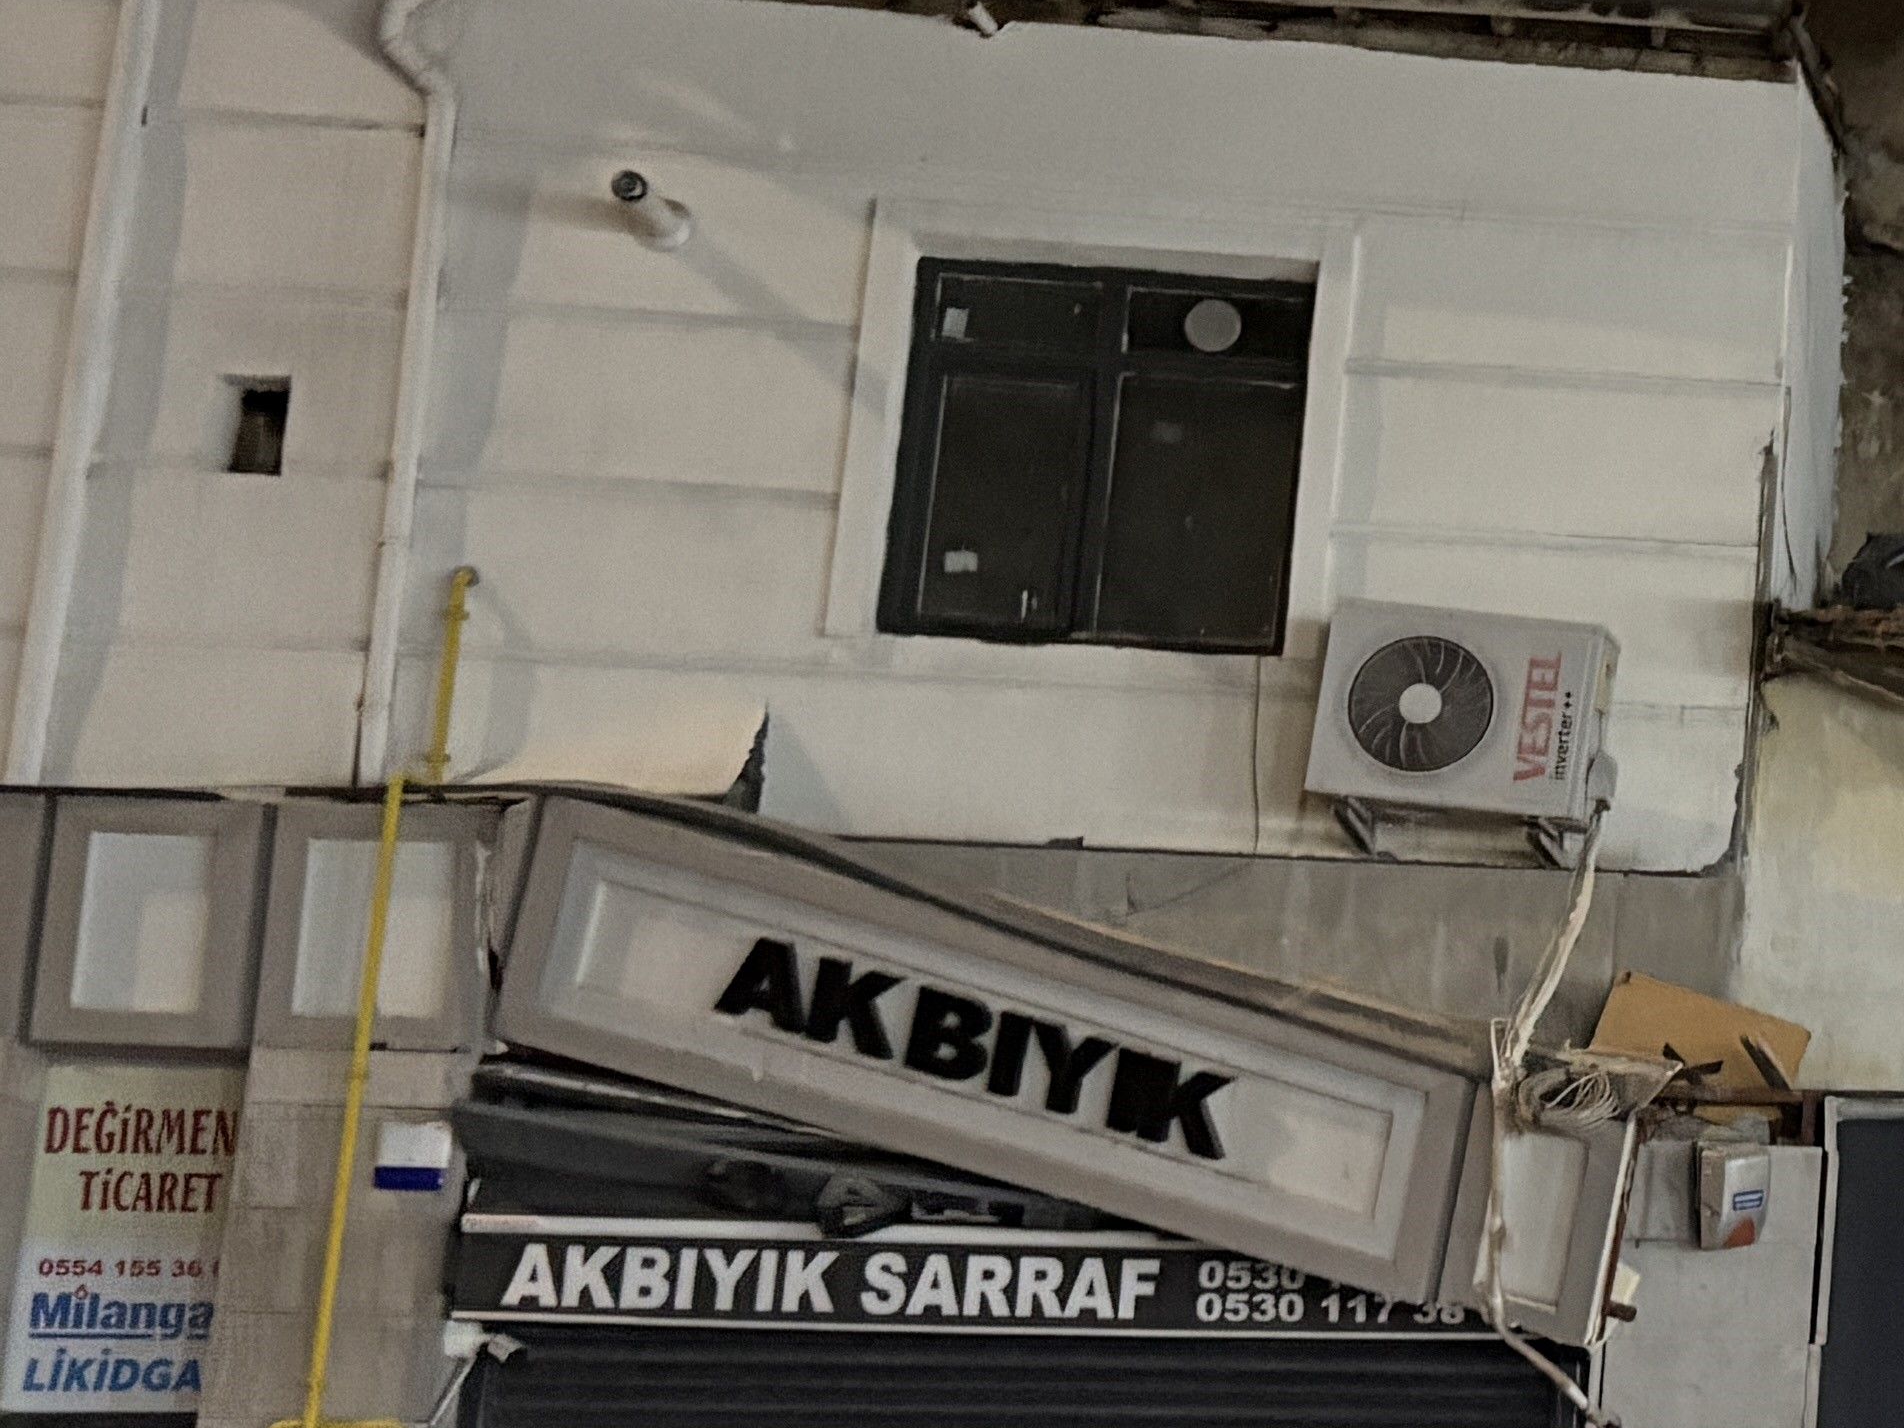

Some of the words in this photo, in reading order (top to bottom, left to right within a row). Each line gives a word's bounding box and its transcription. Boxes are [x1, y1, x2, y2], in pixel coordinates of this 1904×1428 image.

[1512, 651, 1562, 782] VESTEL
[714, 936, 1236, 1159] AKBIYIK
[38, 1258, 103, 1278] 0554
[114, 1259, 162, 1278] 155
[501, 1243, 841, 1314] AKBIYIK
[859, 1251, 1162, 1320] SARRAF
[1199, 1259, 1306, 1290] 0530
[1196, 1292, 1304, 1323] 0530
[1320, 1292, 1394, 1323] 117
[22, 1348, 202, 1392] LİKİDGA
